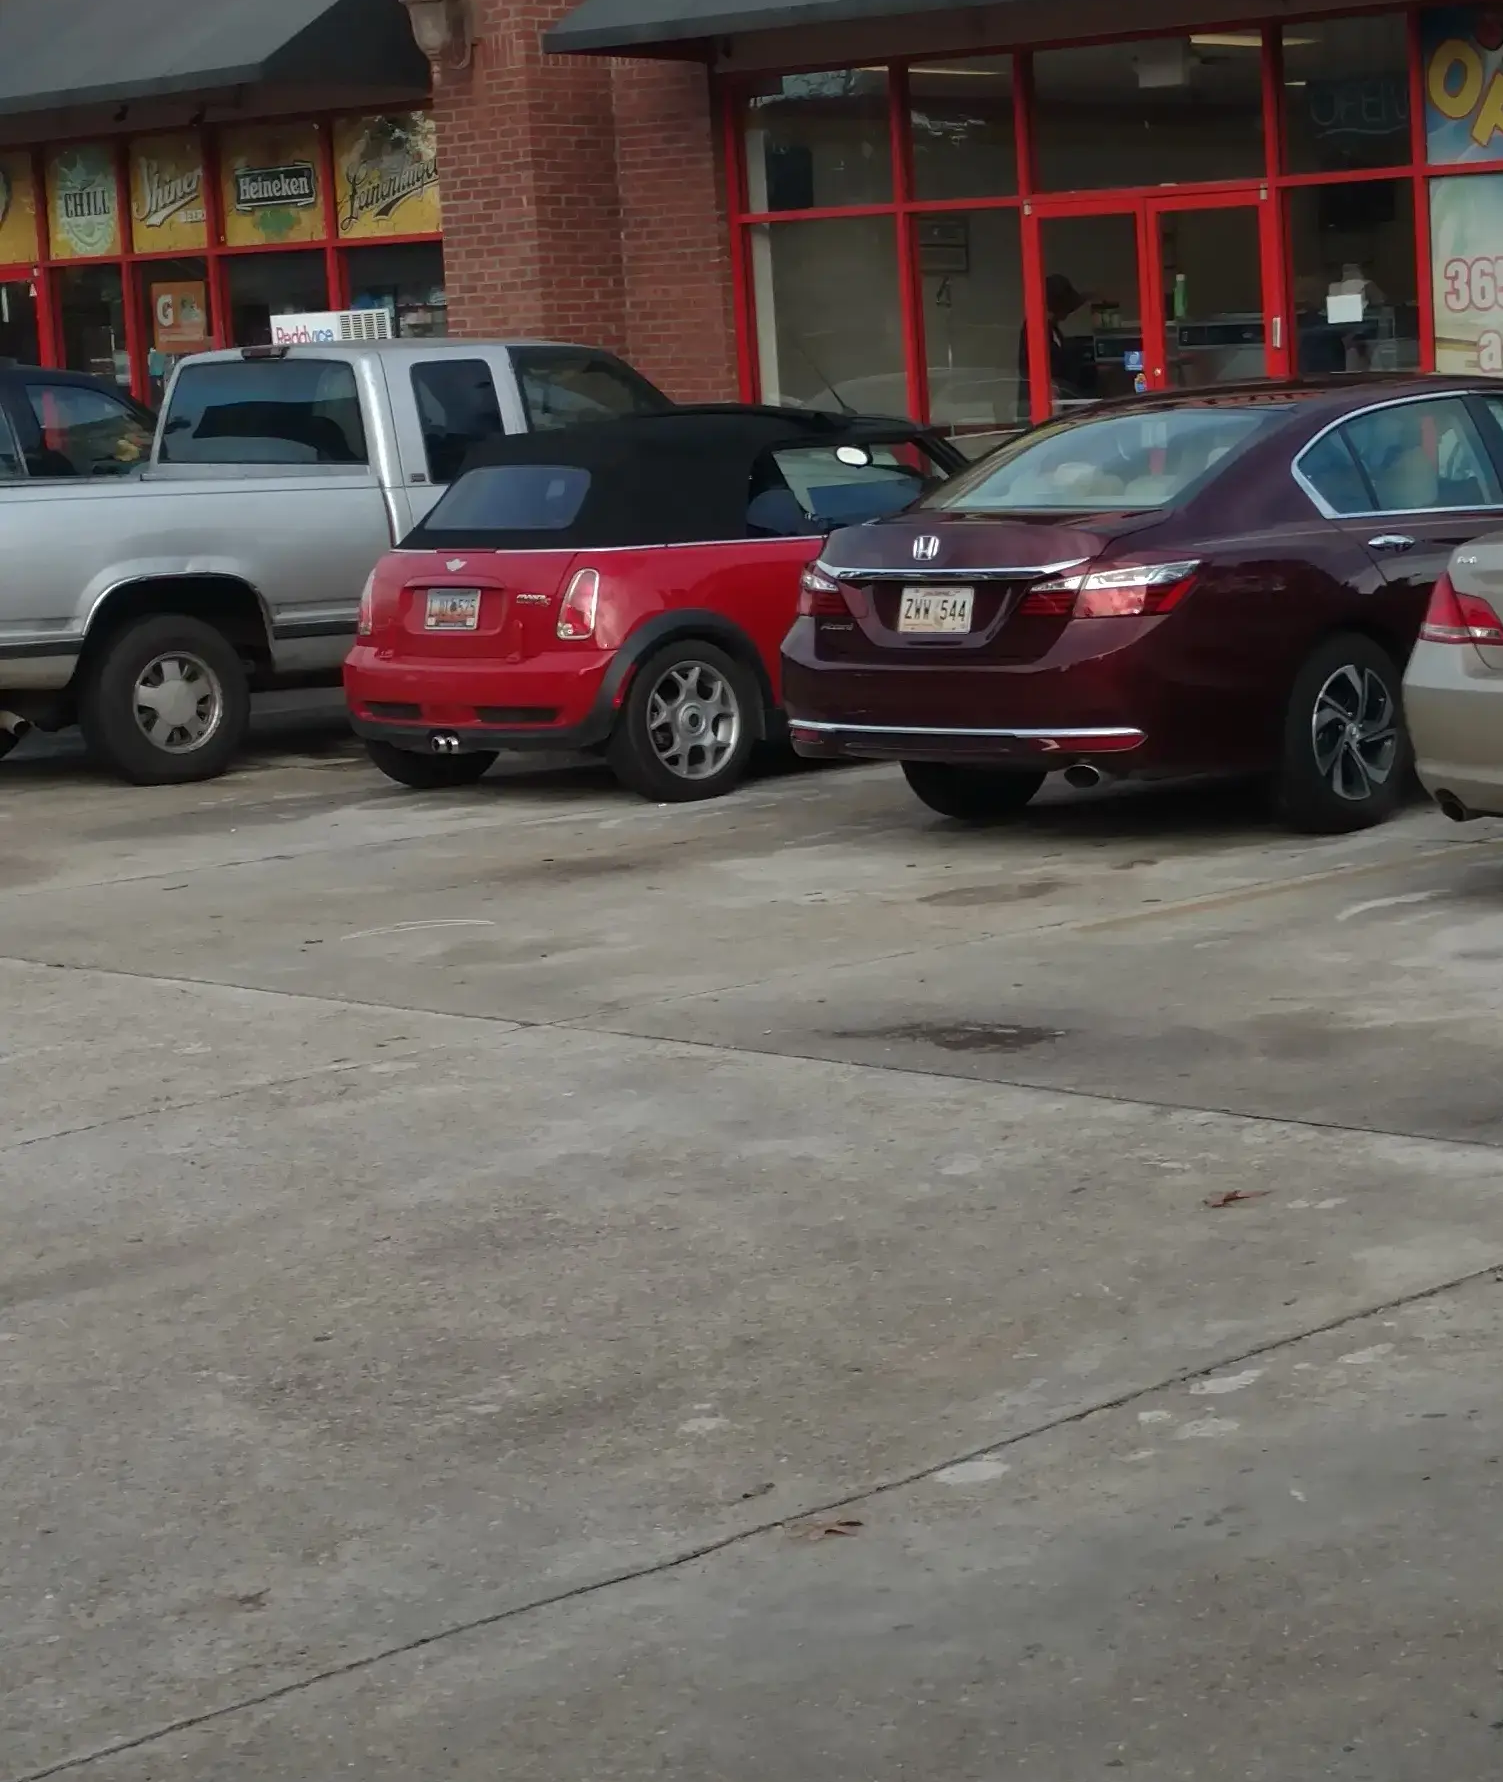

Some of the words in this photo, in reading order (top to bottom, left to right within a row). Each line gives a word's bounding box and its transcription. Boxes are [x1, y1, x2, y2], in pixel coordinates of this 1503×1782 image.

[132, 156, 204, 221] Shiner
[238, 173, 310, 200] Heineken
[63, 189, 111, 218] CHILL
[1477, 329, 1503, 373] a
[904, 598, 931, 620] ZWW
[939, 599, 967, 621] 544
